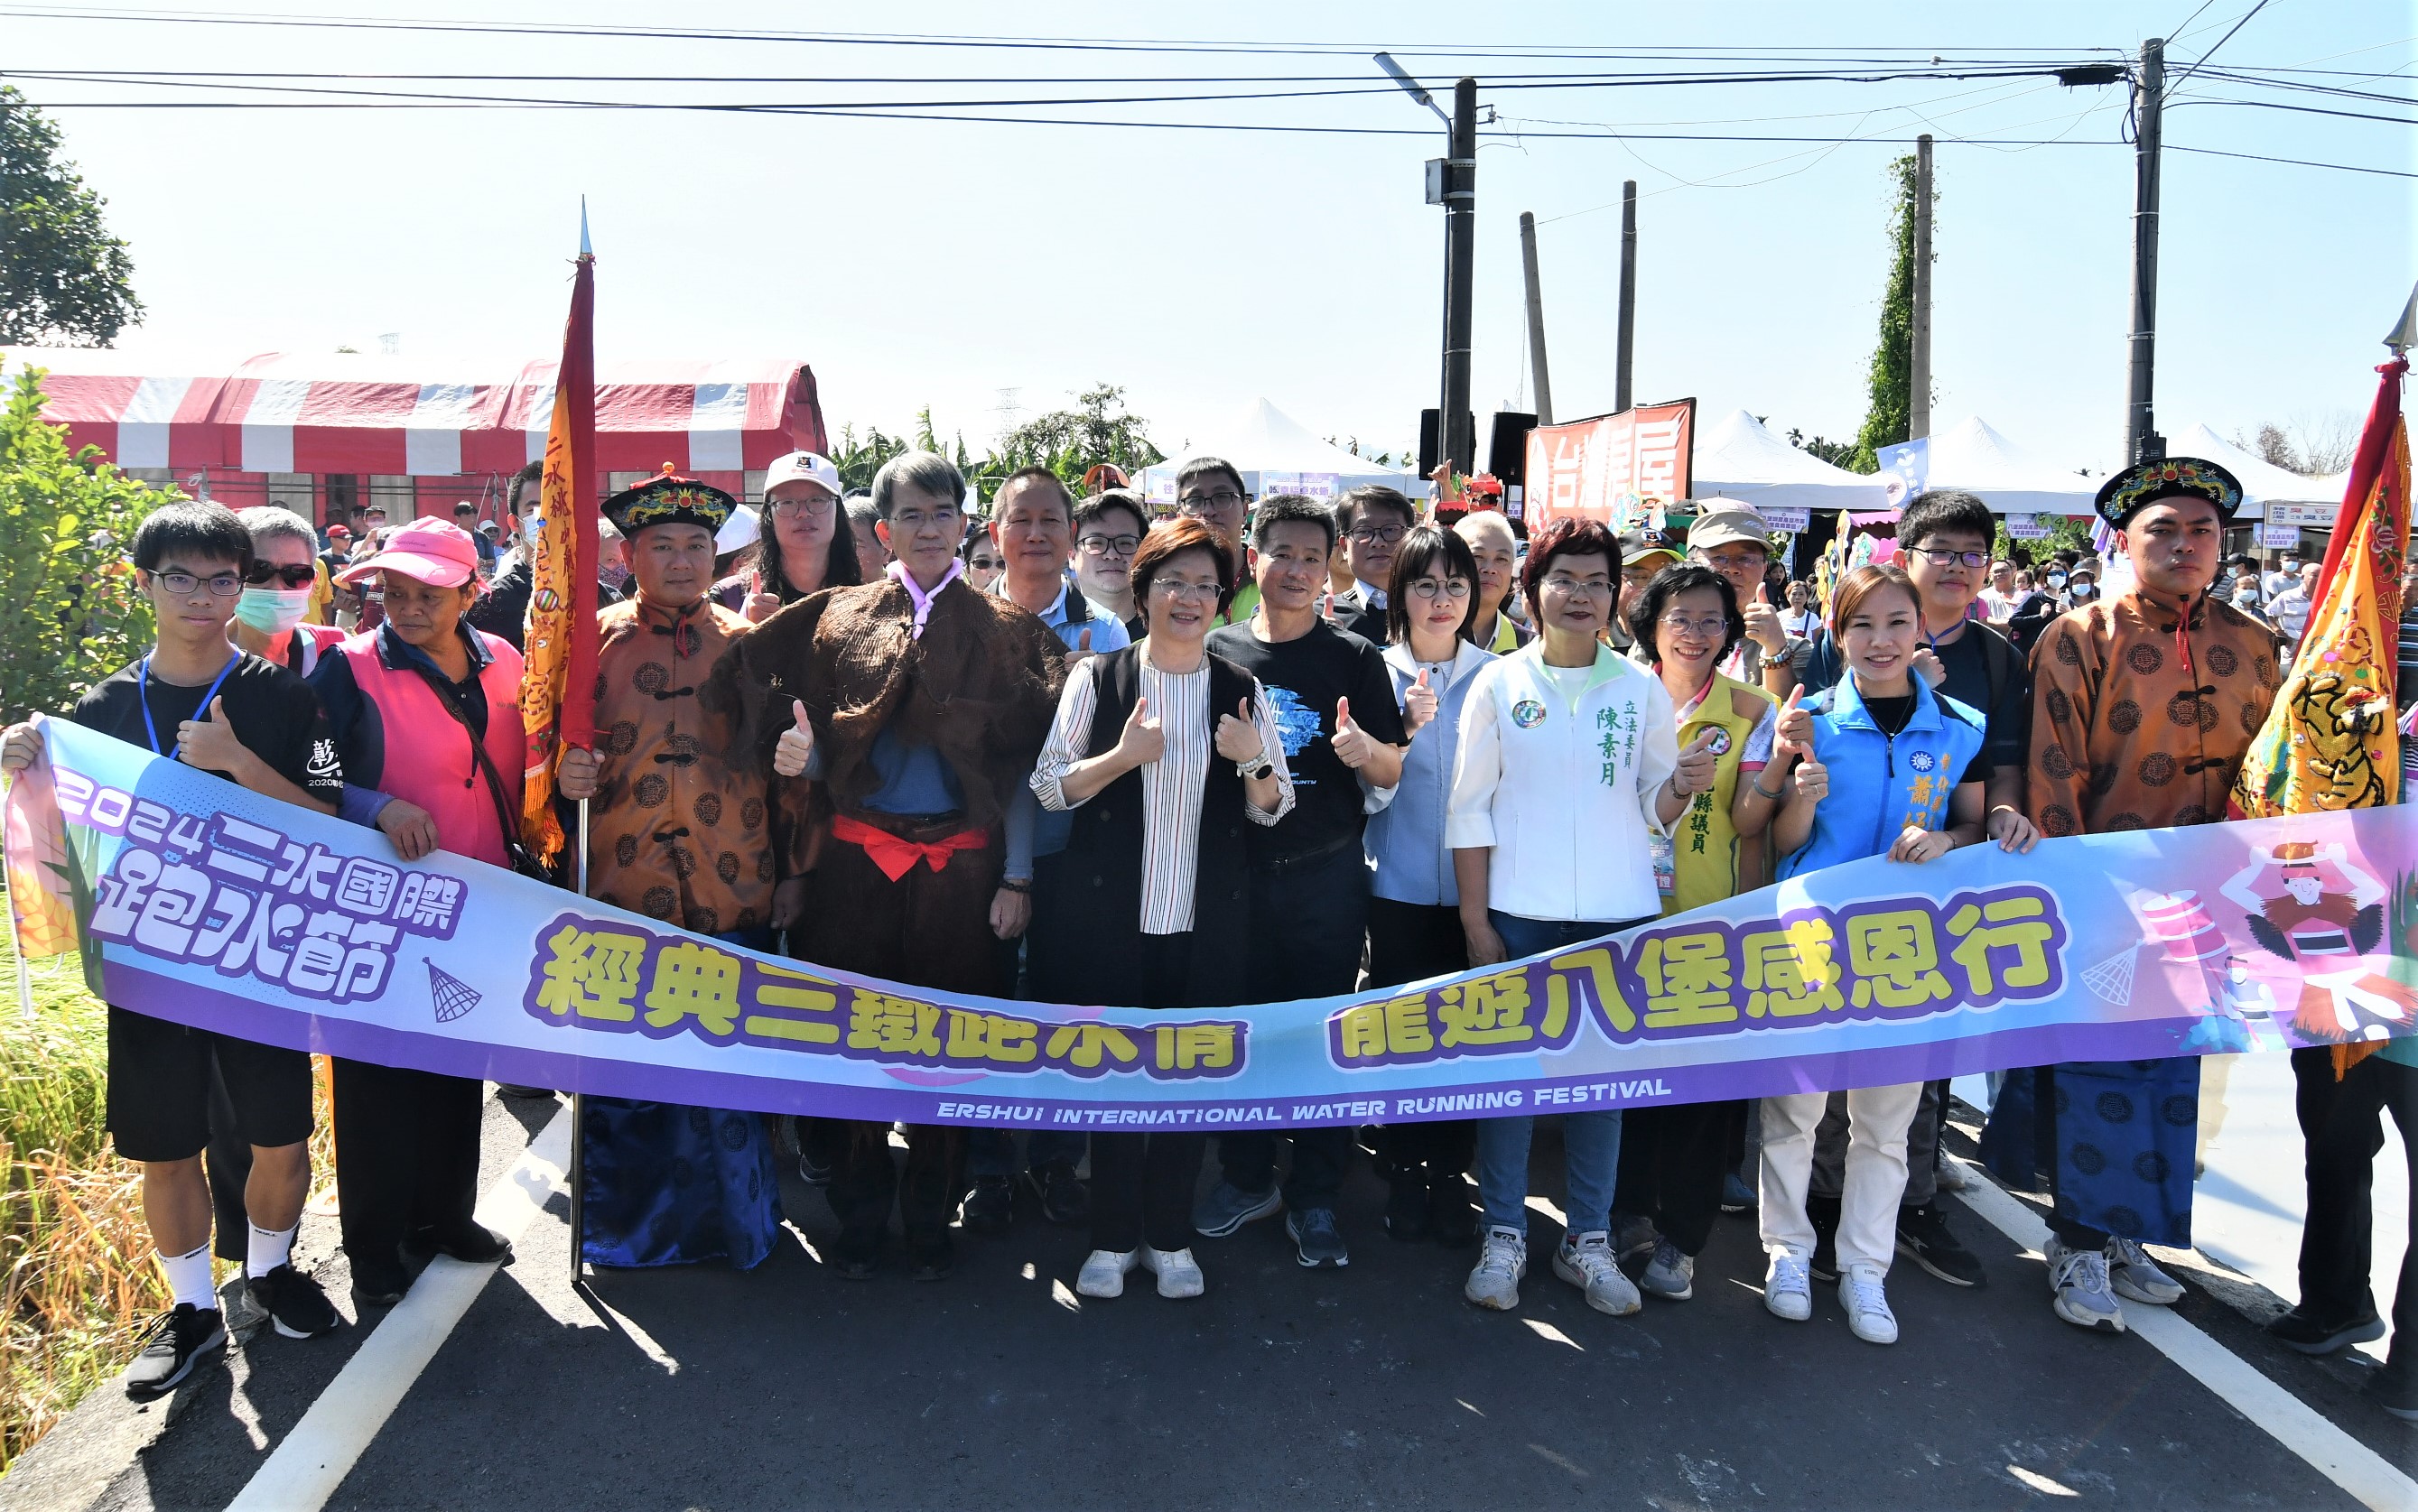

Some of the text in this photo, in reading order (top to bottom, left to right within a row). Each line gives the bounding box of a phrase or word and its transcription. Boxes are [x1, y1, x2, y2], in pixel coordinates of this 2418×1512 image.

[1596, 706, 1623, 787] 陳素月
[1623, 700, 1638, 769] 立法委員
[91, 849, 398, 997] 跑水節
[1340, 896, 2052, 1059] 龍遊八堡感恩行
[536, 923, 1238, 1070] 經典三鐵跑水情
[937, 1078, 1672, 1125] ERSHUI INTERNATIONAL WATER RUNNING FESTIVAL
